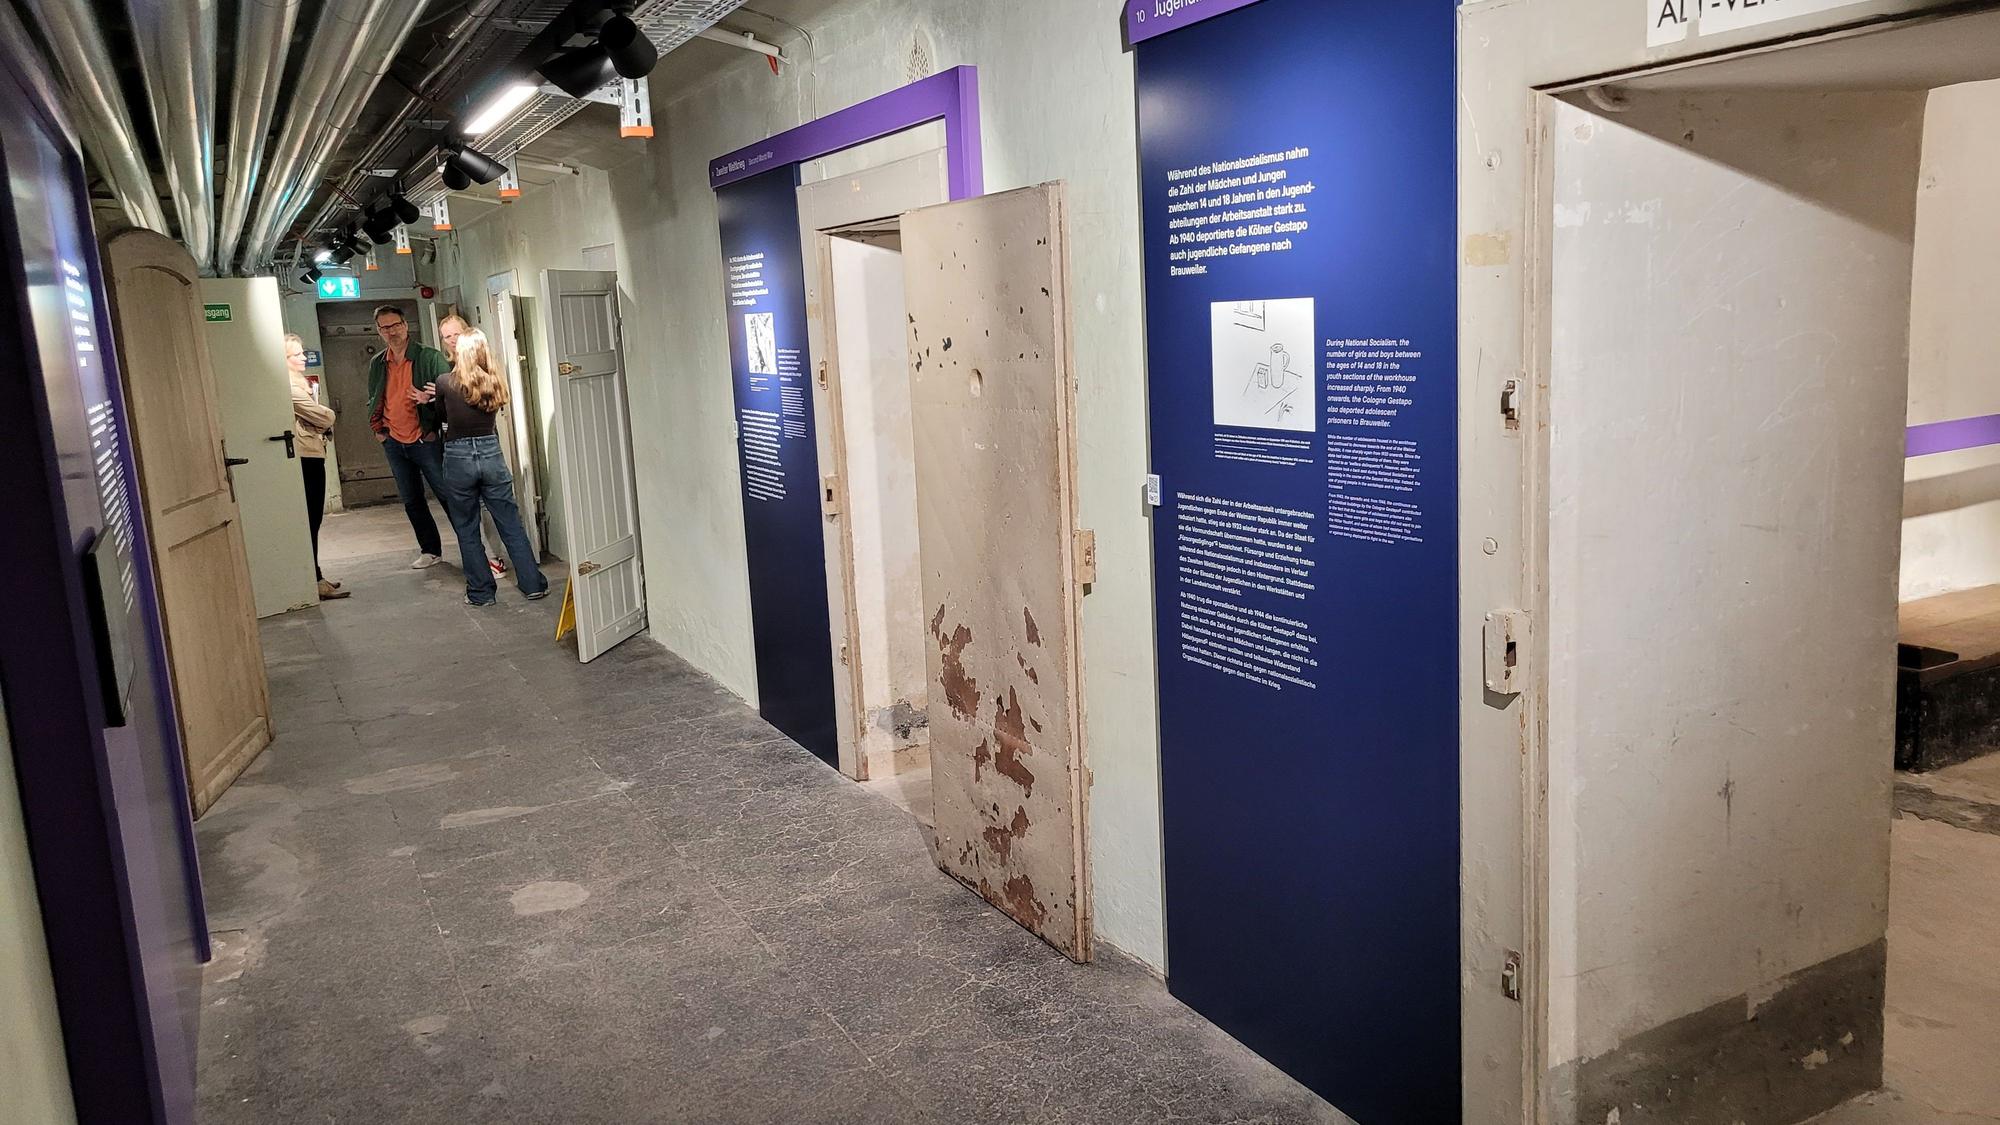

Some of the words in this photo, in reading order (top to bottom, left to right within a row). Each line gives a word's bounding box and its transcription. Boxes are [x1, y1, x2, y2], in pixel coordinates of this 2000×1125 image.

[1136, 10, 1146, 23] 10
[1167, 166, 1197, 180] Während
[1198, 165, 1210, 175] des
[1212, 152, 1284, 172] Nationalsozialismus
[1285, 147, 1308, 159] nahm
[1168, 186, 1178, 197] die
[1179, 183, 1194, 195] Zahl
[1195, 182, 1206, 192] der
[1207, 177, 1241, 190] Mädchen
[1242, 172, 1257, 185] und
[1258, 170, 1286, 183] Jungen
[1168, 200, 1198, 213] zwischen
[1199, 197, 1206, 208] 14
[1207, 195, 1221, 207] und
[1222, 194, 1230, 205] 18
[1231, 192, 1255, 204] Jahren
[1256, 189, 1264, 200] in
[1265, 187, 1280, 198] den
[1282, 181, 1315, 197] Jugend-
[1169, 216, 1208, 228] abteilungen
[1209, 213, 1221, 223] der
[1221, 206, 1272, 221] Arbeitsanstalt
[1273, 202, 1292, 215] stark
[1294, 203, 1306, 212] zu.
[1169, 234, 1178, 244] Ab
[1180, 232, 1195, 243] 1940
[1196, 228, 1234, 242] deportierte
[1235, 226, 1247, 237] die
[1248, 224, 1272, 235] Kölner
[1274, 220, 1307, 232] Gestapo
[1170, 249, 1186, 260] auch
[1187, 246, 1227, 260] jugendliche
[1228, 243, 1270, 255] Gefangene
[1271, 238, 1291, 250] nach
[1170, 264, 1207, 275] Brauweiler.
[1326, 338, 1344, 348] During
[1354, 350, 1366, 359] girls
[1379, 350, 1393, 359] boys
[1362, 395, 1386, 405] Cologne
[1387, 396, 1412, 406] Gestapo
